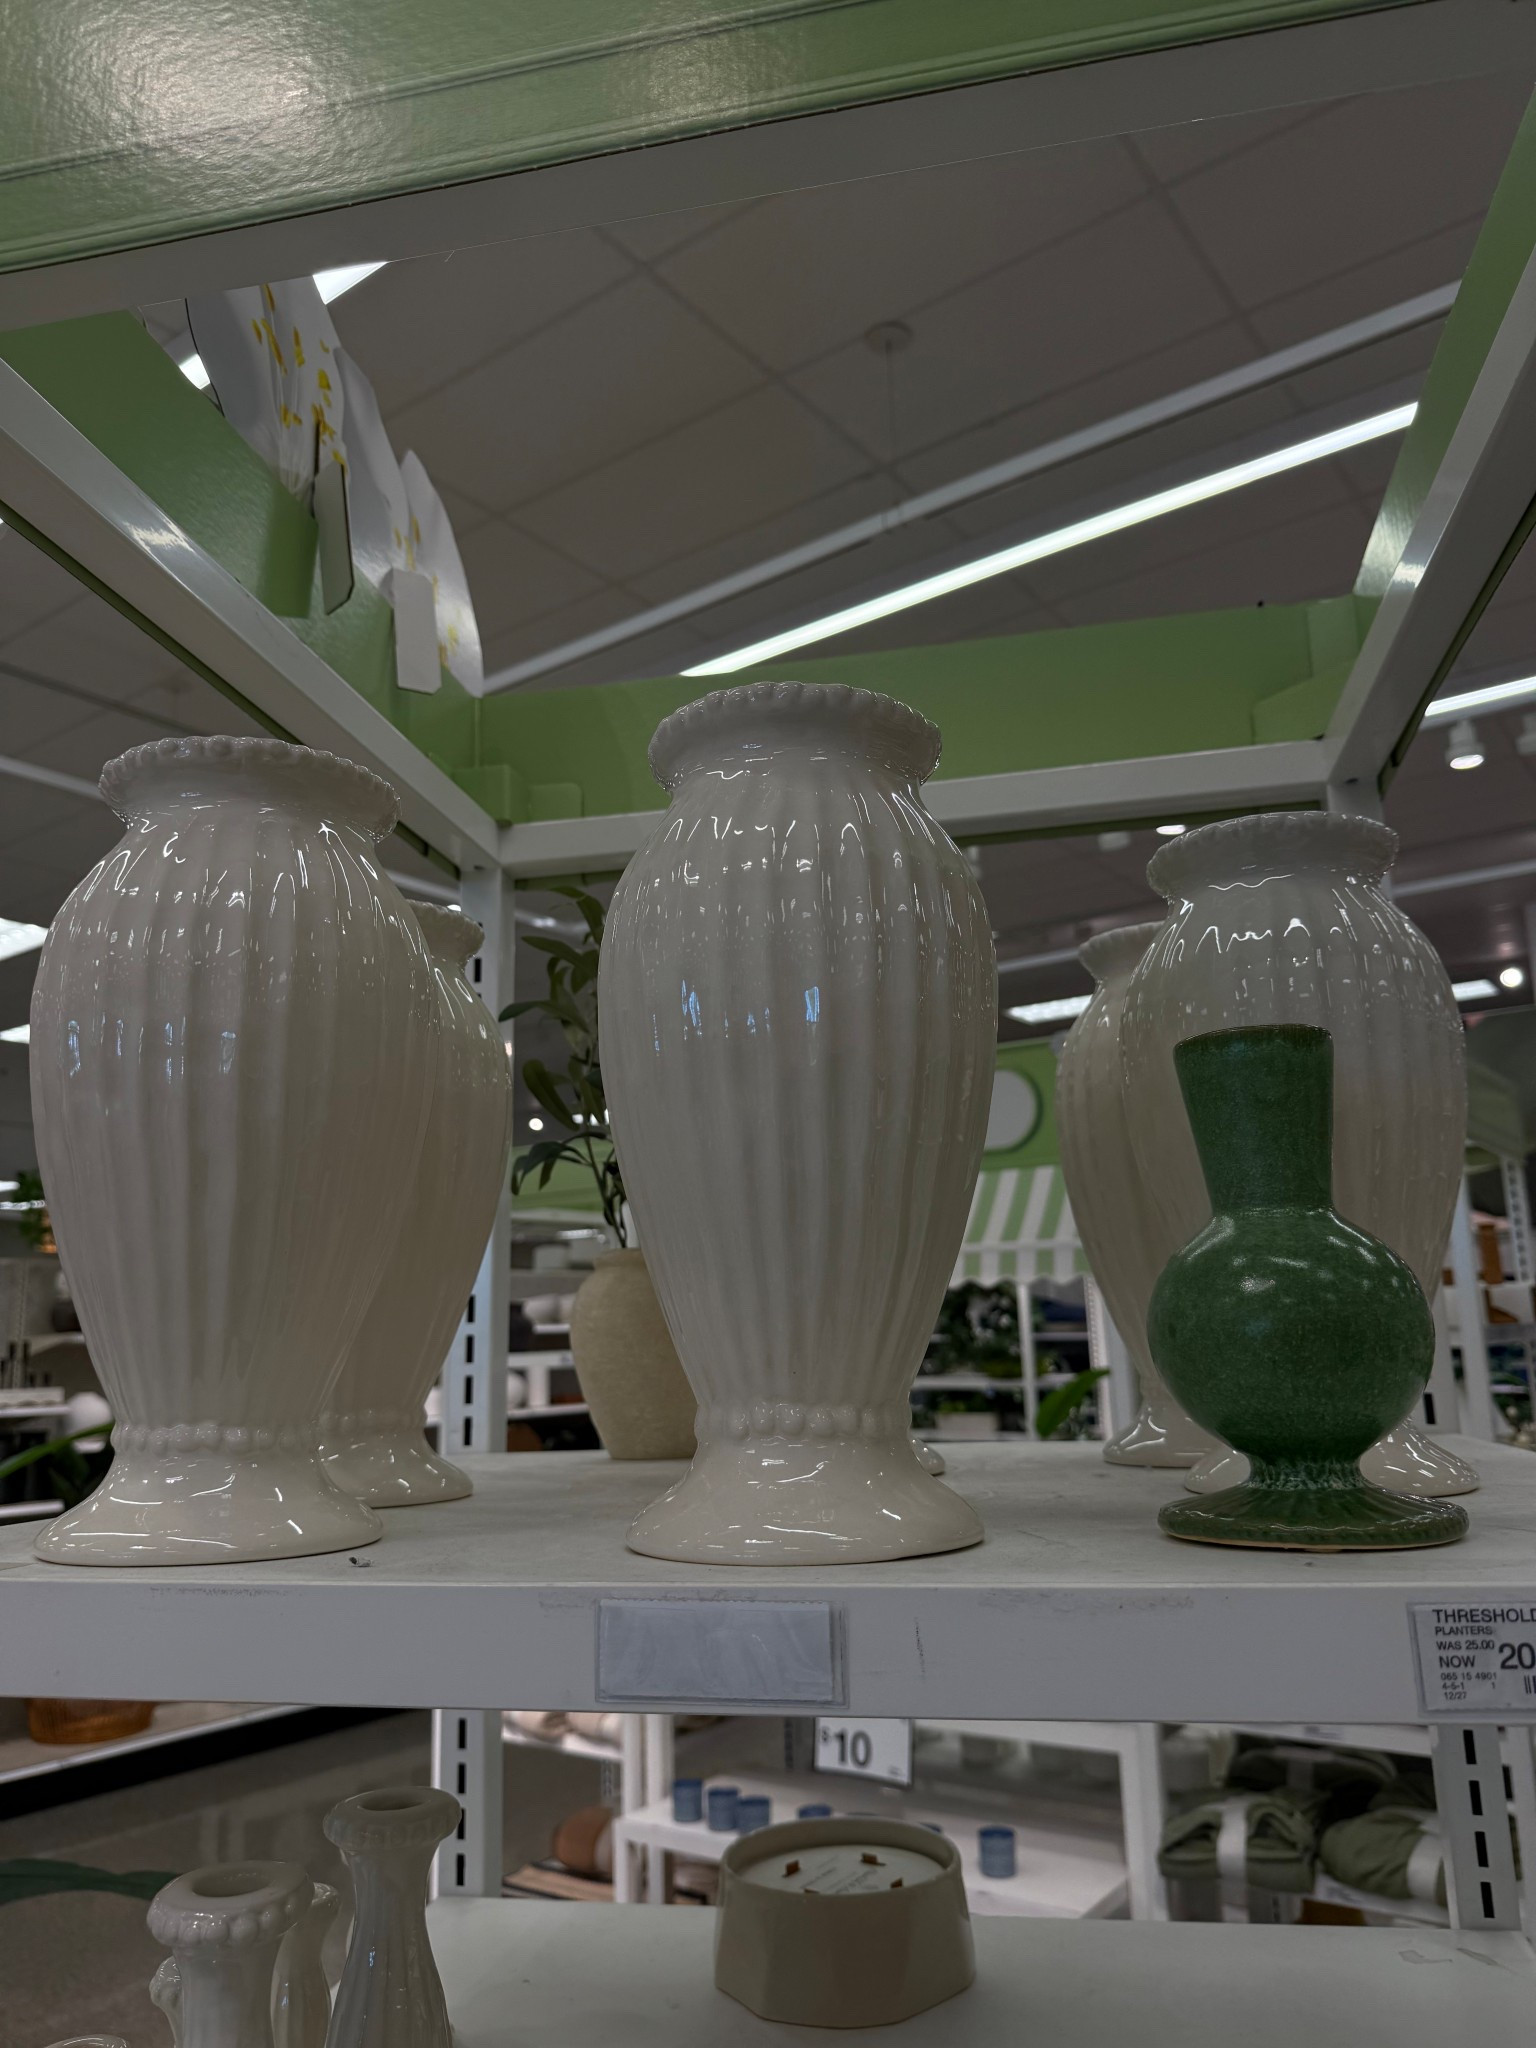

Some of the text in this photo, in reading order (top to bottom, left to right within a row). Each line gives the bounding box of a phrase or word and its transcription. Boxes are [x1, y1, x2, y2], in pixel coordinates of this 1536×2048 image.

[1435, 1626, 1493, 1636] PLANTERS
[1436, 1640, 1495, 1650] WAS 25.00
[1439, 1655, 1476, 1668] NOW
